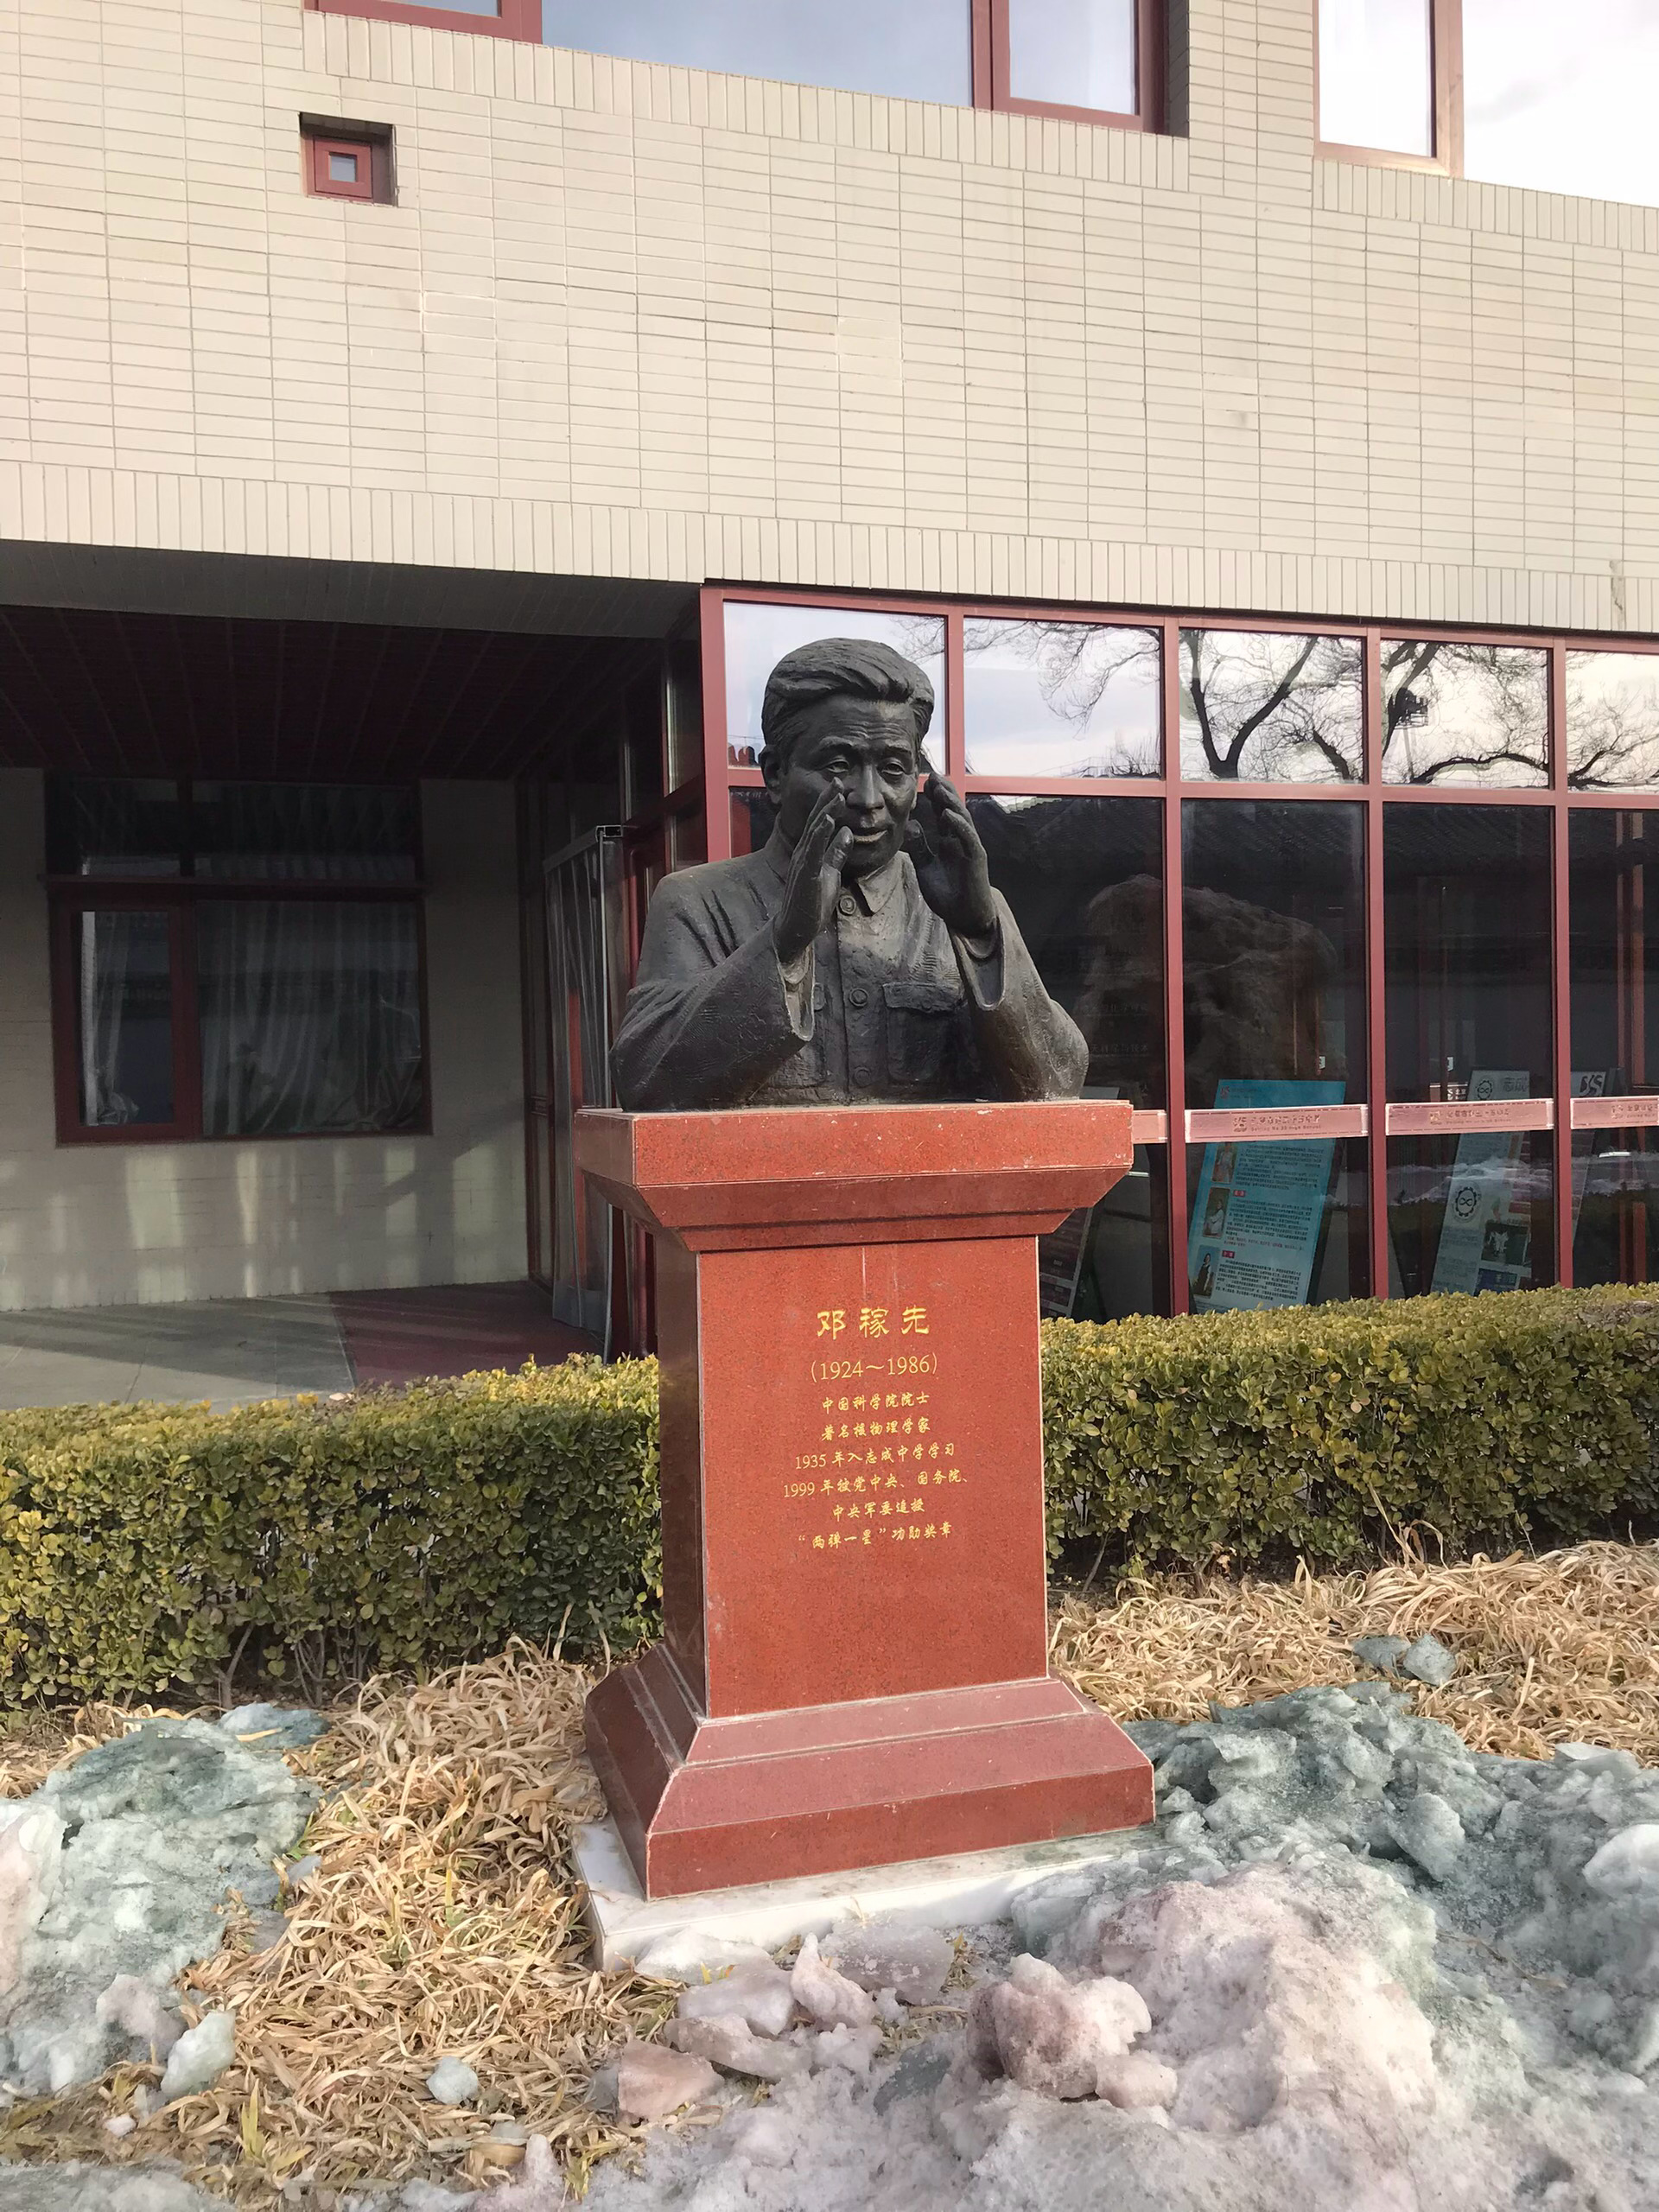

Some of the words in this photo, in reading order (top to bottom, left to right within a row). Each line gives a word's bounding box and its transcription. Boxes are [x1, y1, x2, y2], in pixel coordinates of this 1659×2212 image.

[817, 1305, 930, 1340] 邓稼先
[821, 1391, 931, 1414] 中国科学院院士
[821, 1416, 931, 1442] 著名核物理学家
[832, 1498, 925, 1522] 中央军委追授
